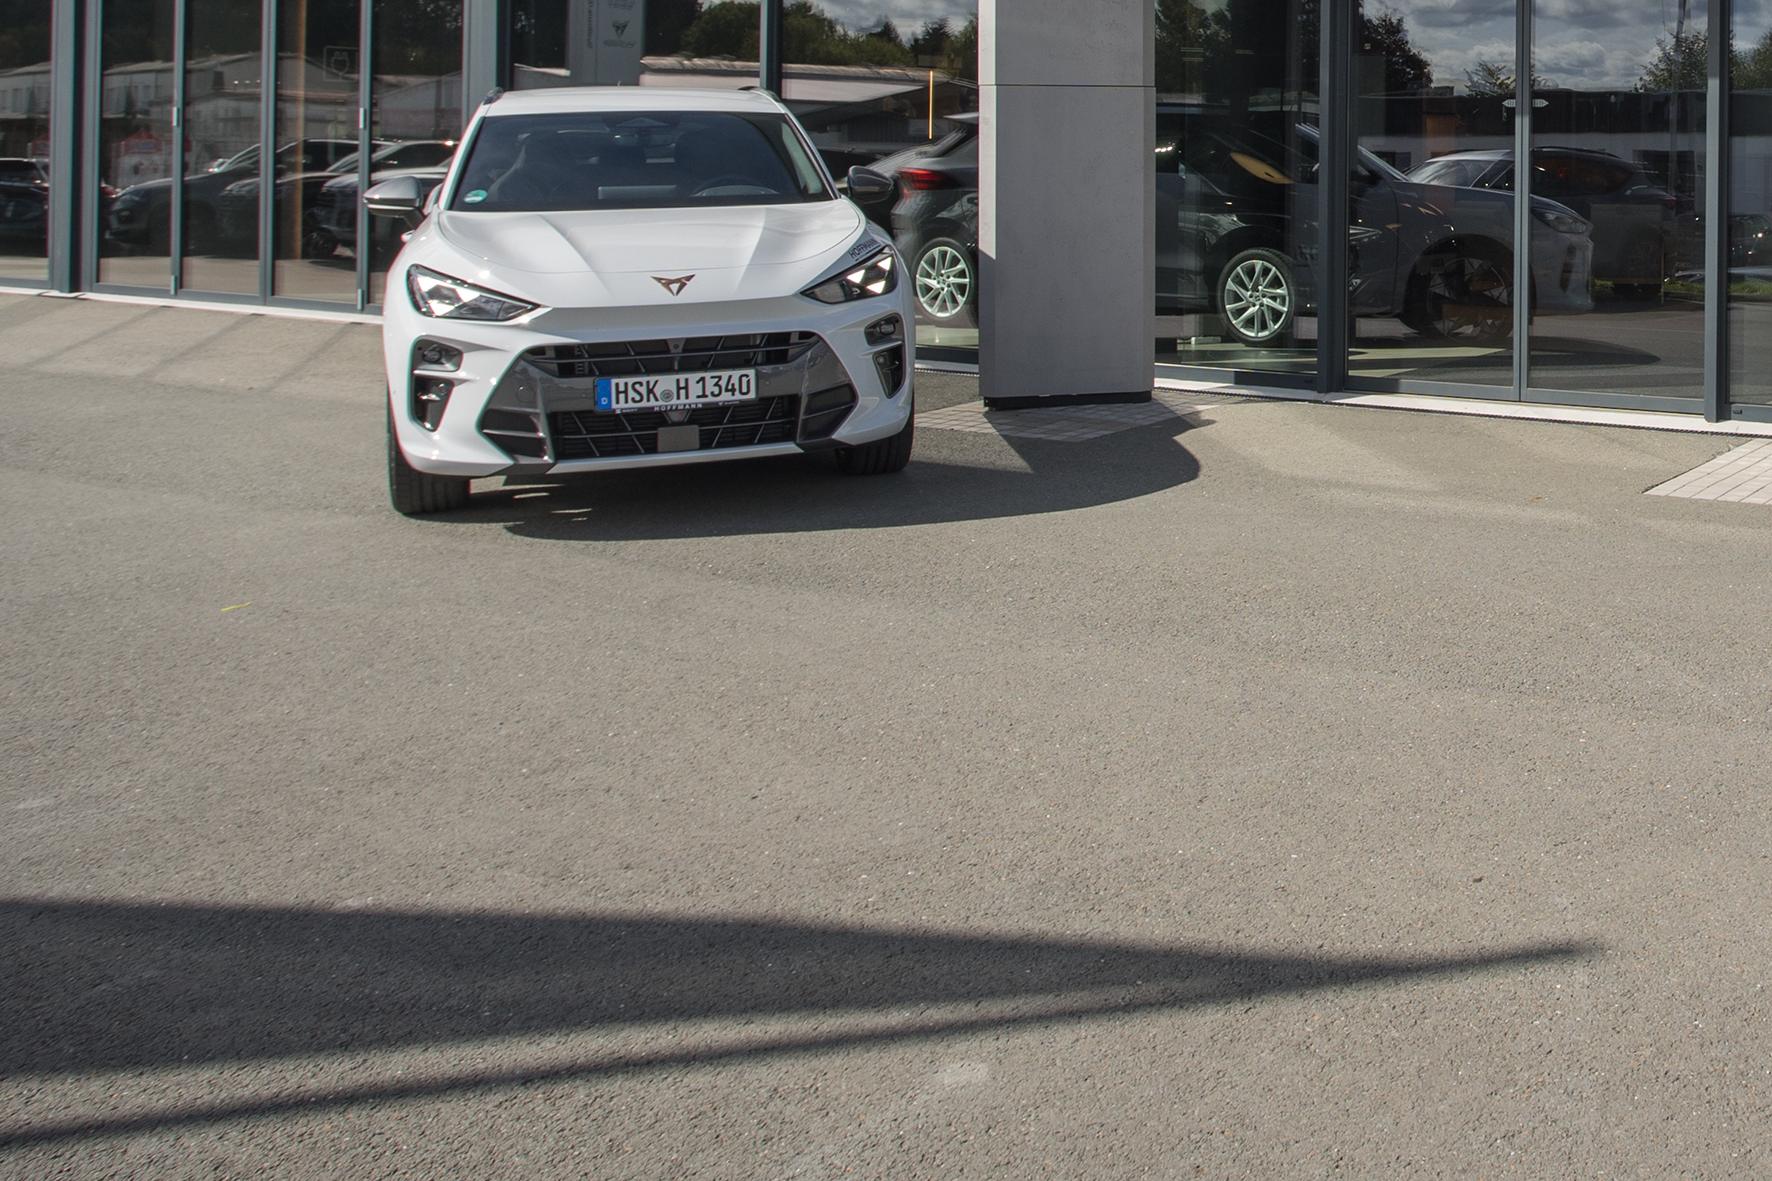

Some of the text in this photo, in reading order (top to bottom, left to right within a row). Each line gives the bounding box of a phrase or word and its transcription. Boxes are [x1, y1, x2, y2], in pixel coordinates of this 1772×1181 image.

[615, 373, 751, 405] HSK H 1340
[601, 397, 608, 405] D
[653, 403, 703, 412] HOFFMANN
